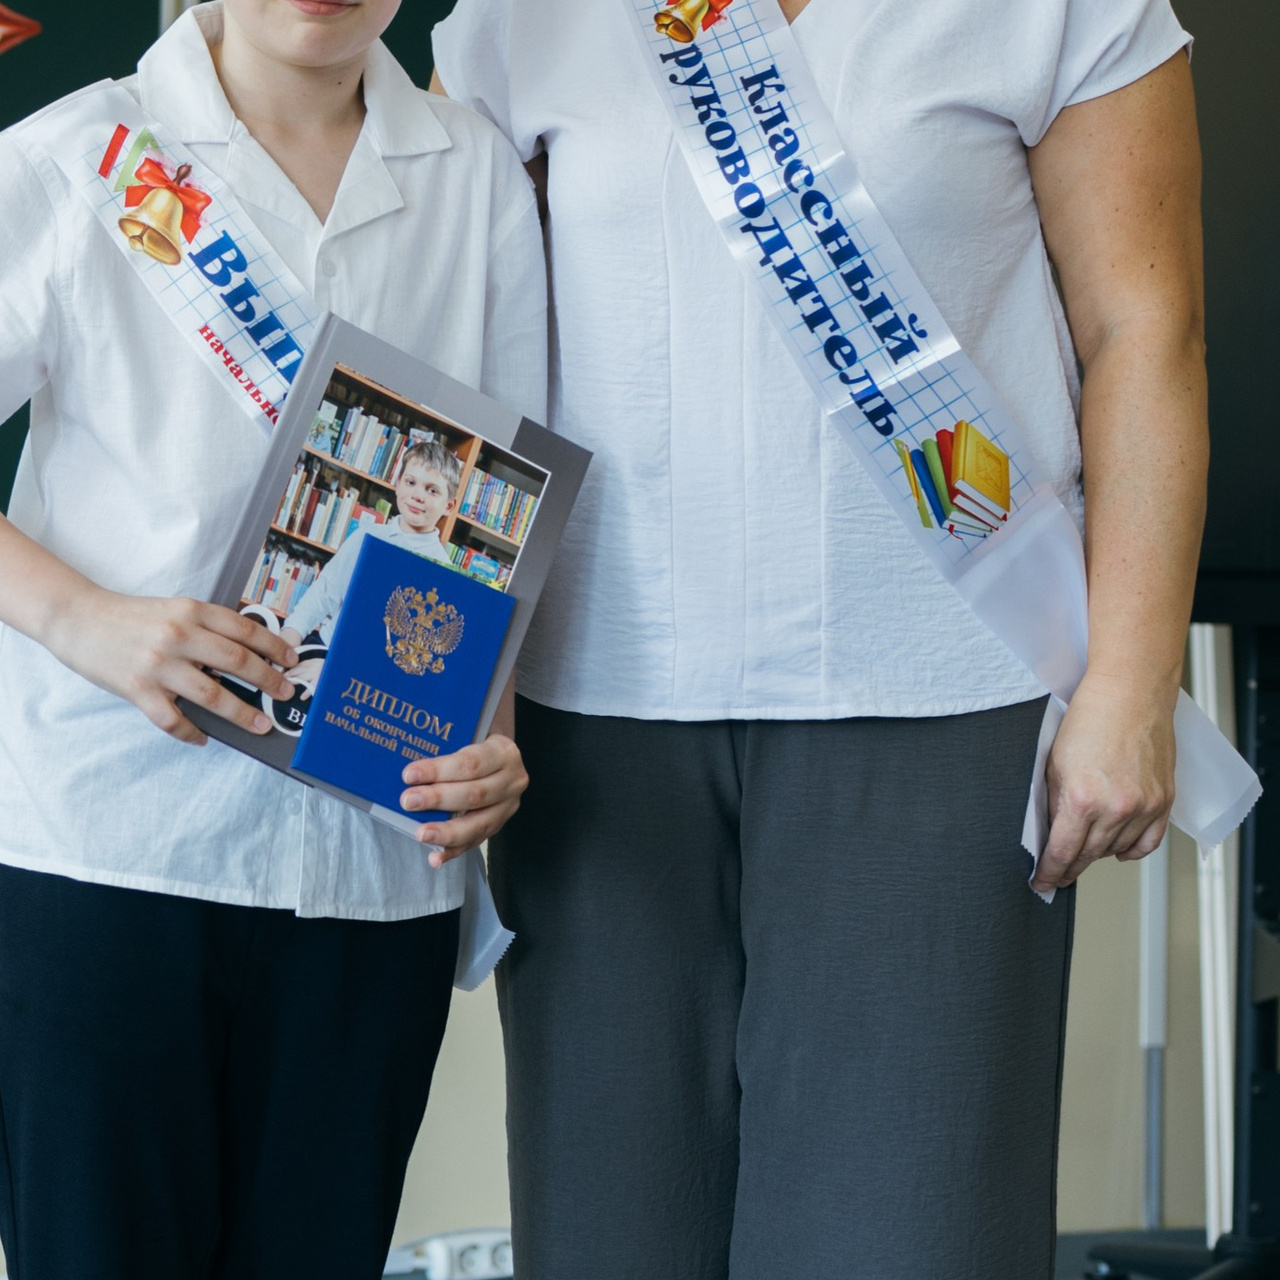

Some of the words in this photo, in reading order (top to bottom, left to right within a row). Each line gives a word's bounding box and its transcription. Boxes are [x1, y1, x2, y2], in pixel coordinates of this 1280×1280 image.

[659, 43, 897, 437] руководитель
[739, 63, 928, 366] Классный
[187, 229, 305, 401] Вып
[324, 711, 398, 752] НАЧАЛЬНОЙ
[340, 677, 455, 742] ДИПЛОМ
[343, 705, 361, 719] ОБ
[364, 713, 441, 756] ОКОНЧАНИИ
